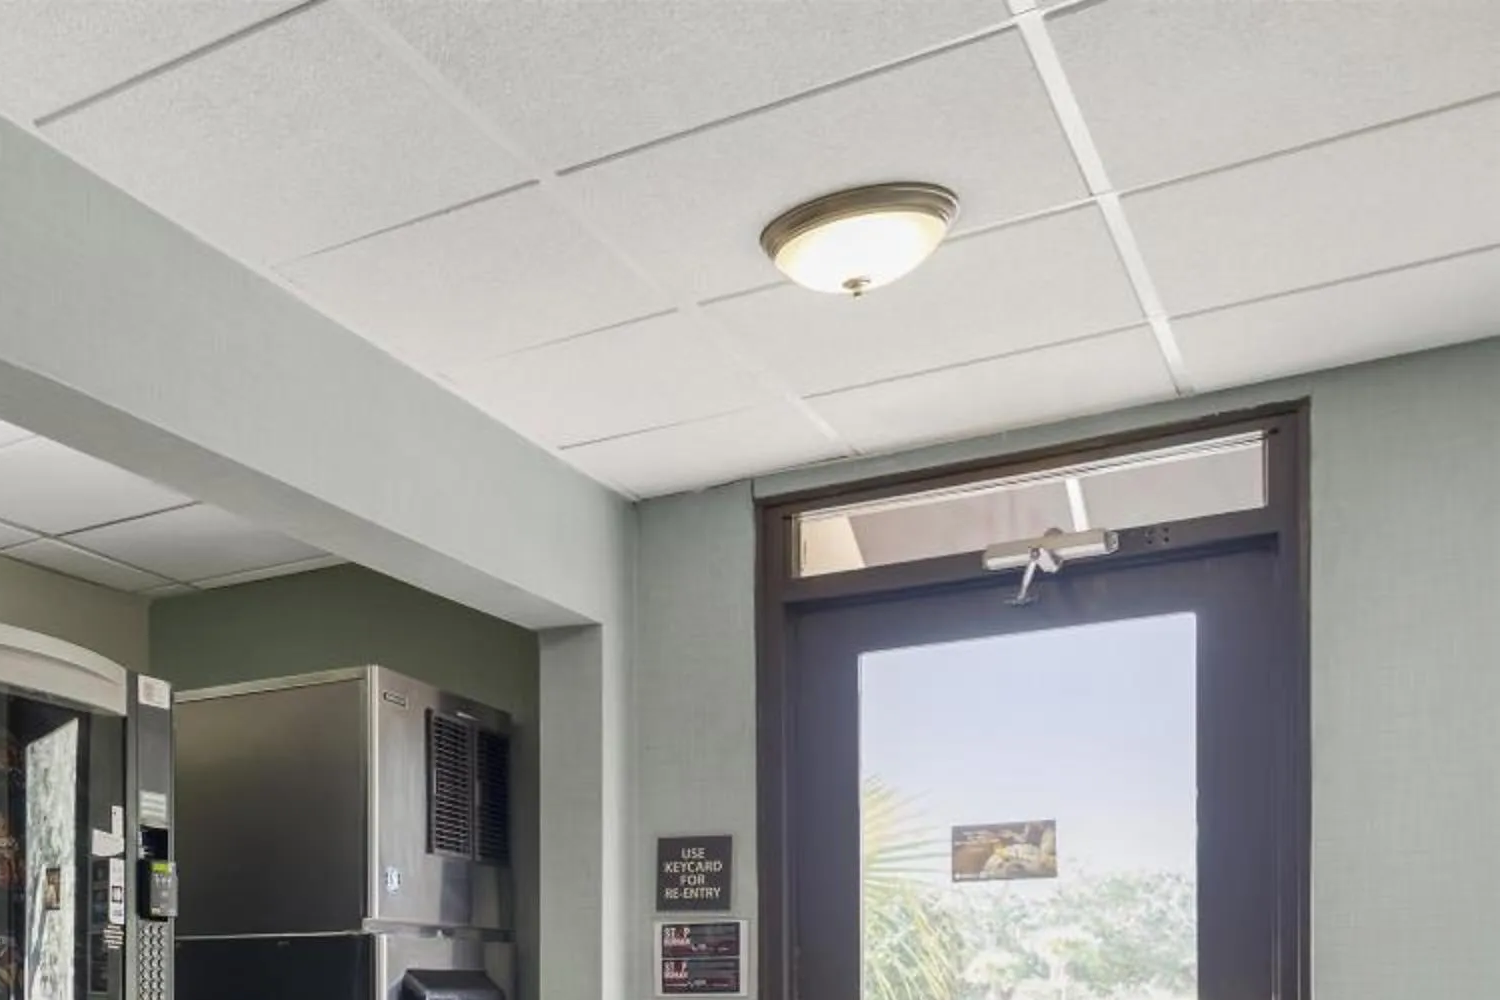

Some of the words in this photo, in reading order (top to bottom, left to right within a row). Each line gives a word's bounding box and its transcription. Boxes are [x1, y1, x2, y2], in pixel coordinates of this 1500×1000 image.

[681, 847, 705, 859] USE
[664, 861, 723, 874] KEYCARD
[680, 874, 705, 886] FOR
[665, 887, 721, 900] RE-ENTRY
